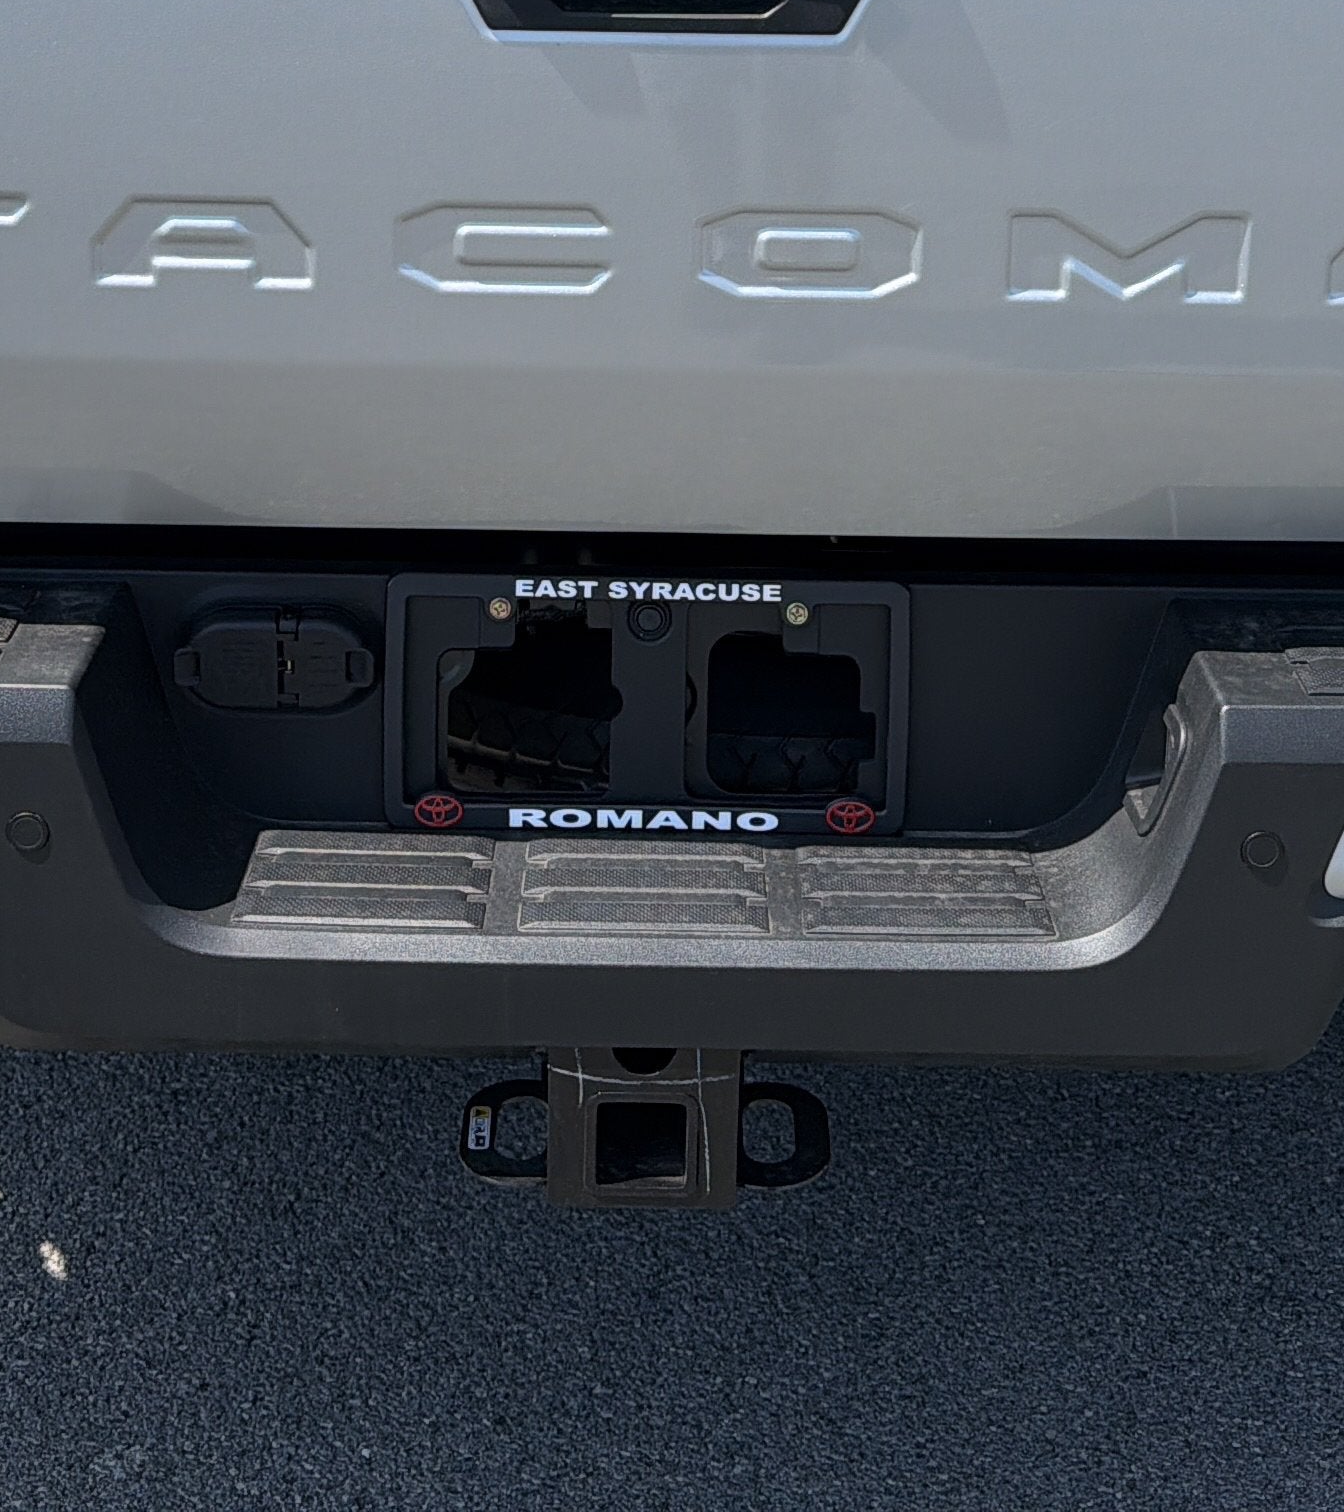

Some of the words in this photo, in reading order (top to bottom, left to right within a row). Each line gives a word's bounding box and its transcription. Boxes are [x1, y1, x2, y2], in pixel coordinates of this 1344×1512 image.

[514, 578, 599, 599] EAST
[608, 580, 783, 603] SYRACUSE
[508, 807, 780, 832] ROMANO
